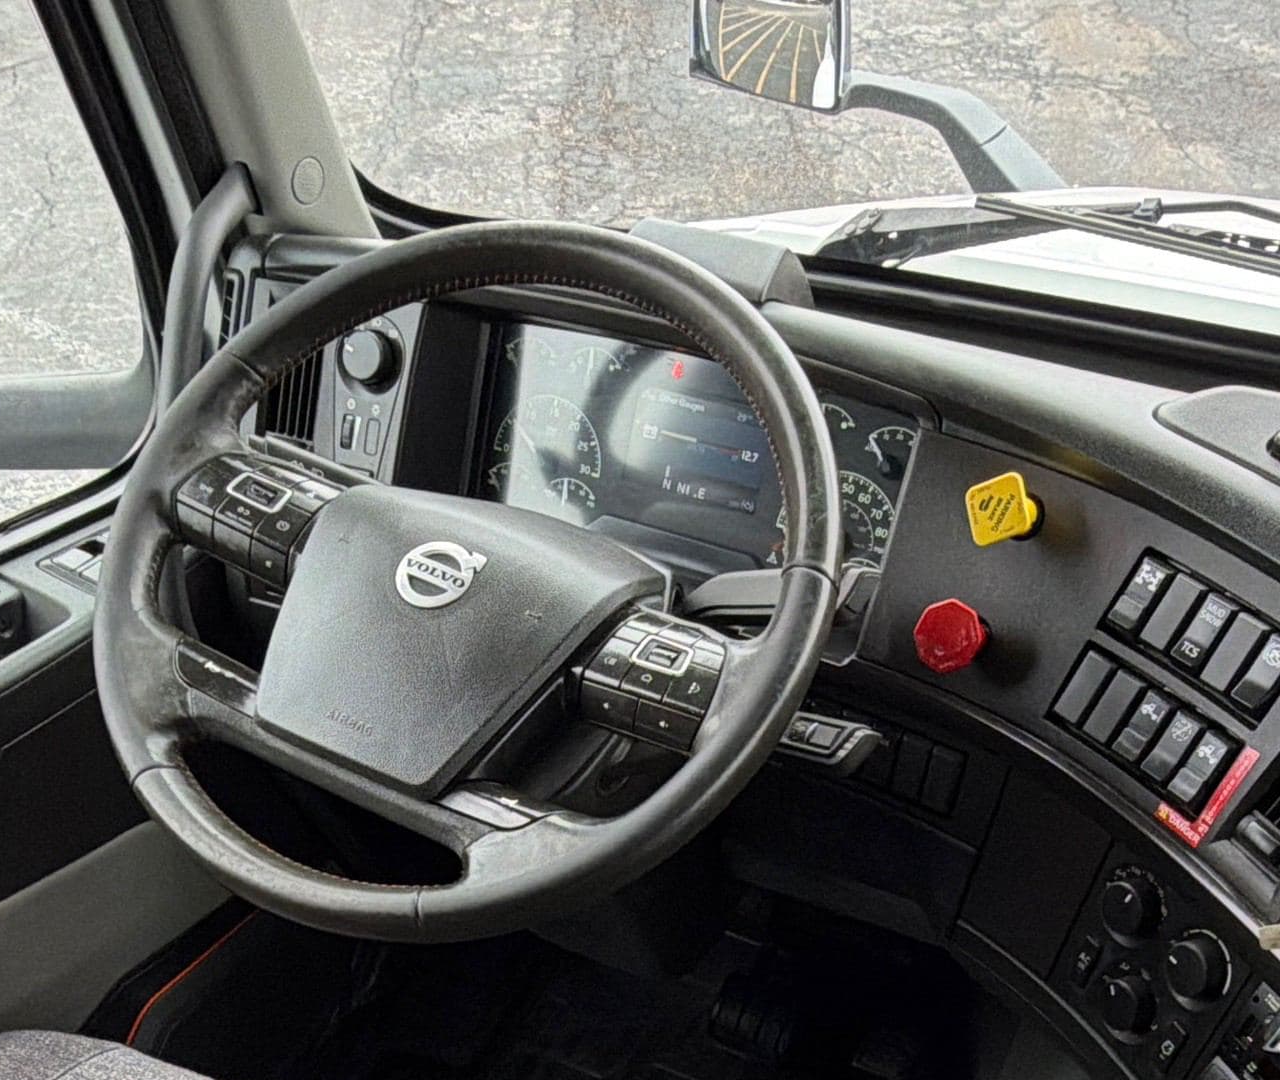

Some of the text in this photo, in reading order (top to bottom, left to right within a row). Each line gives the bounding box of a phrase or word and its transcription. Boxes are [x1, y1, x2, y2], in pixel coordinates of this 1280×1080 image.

[577, 440, 589, 452] 25
[579, 464, 591, 475] 30
[841, 483, 855, 494] 50
[858, 493, 871, 504] 60
[870, 508, 883, 520] 70
[875, 527, 888, 538] 80
[406, 557, 466, 590] VOLVO
[1180, 640, 1200, 658] TCS
